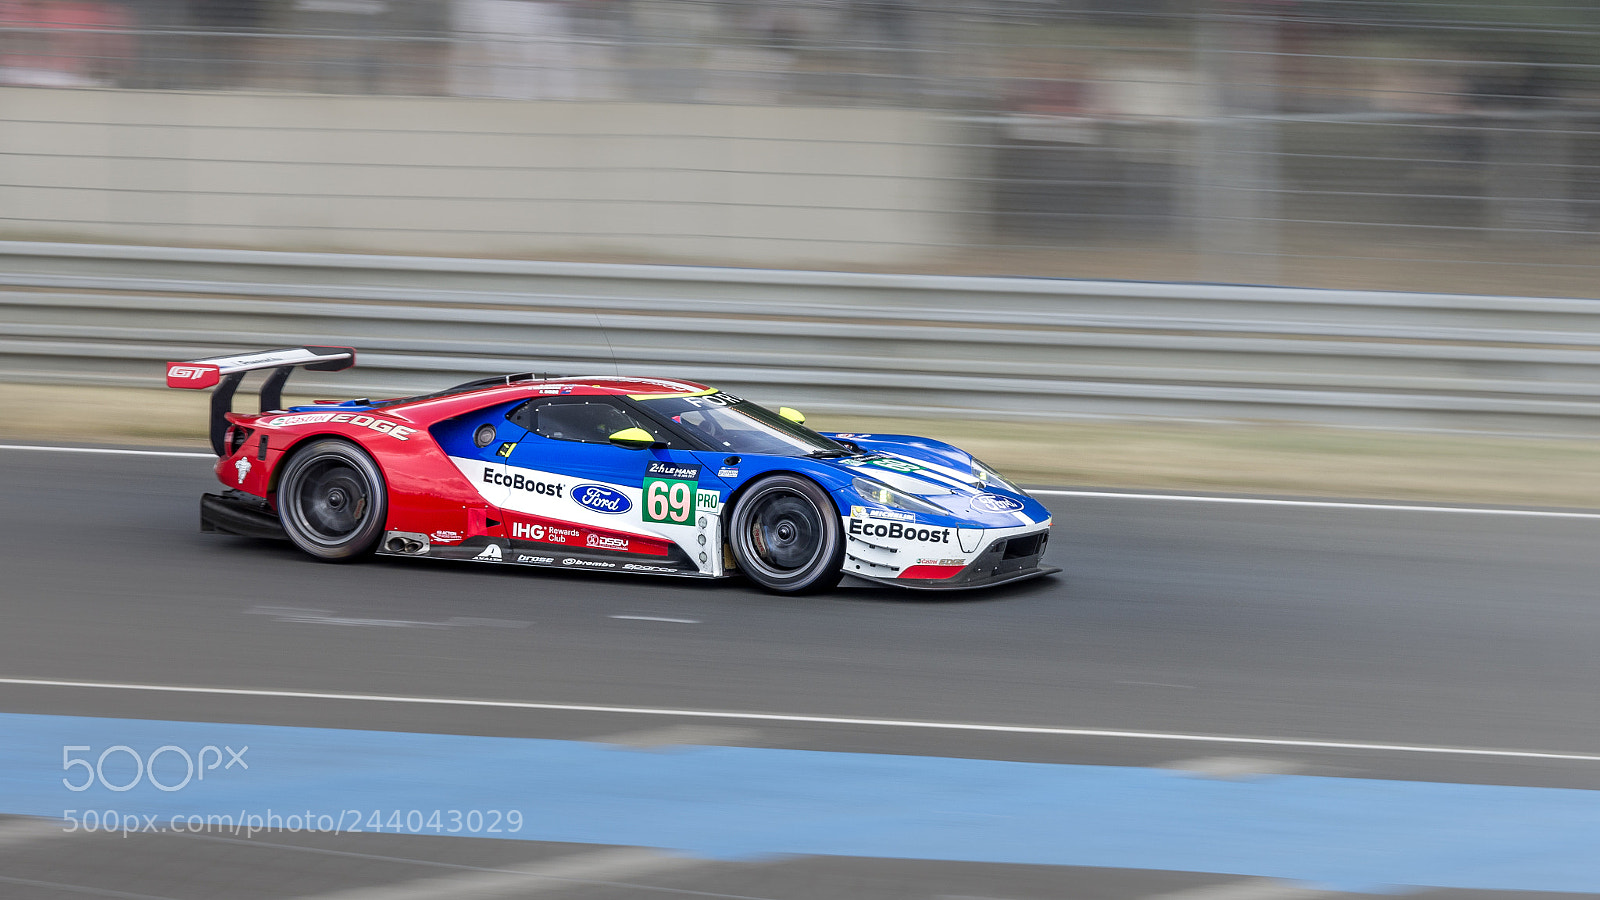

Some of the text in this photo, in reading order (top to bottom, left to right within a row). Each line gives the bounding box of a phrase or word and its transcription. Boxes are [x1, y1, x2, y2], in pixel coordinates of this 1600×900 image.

[168, 365, 218, 380] GT
[283, 413, 418, 441] Castrol EDGE
[674, 467, 698, 475] MANS
[482, 467, 565, 498] EcoBoost
[581, 486, 620, 512] Ford
[647, 480, 691, 523] 69
[696, 492, 718, 509] PRO
[869, 509, 915, 521] MICHELIN
[512, 522, 544, 540] IHG
[548, 525, 580, 538] Rewards
[548, 533, 566, 543] Club
[849, 518, 950, 544] EcoBoost
[517, 554, 554, 564] brose
[575, 560, 616, 568] brembo
[939, 558, 966, 566] EDGE
[621, 563, 678, 573] sparco
